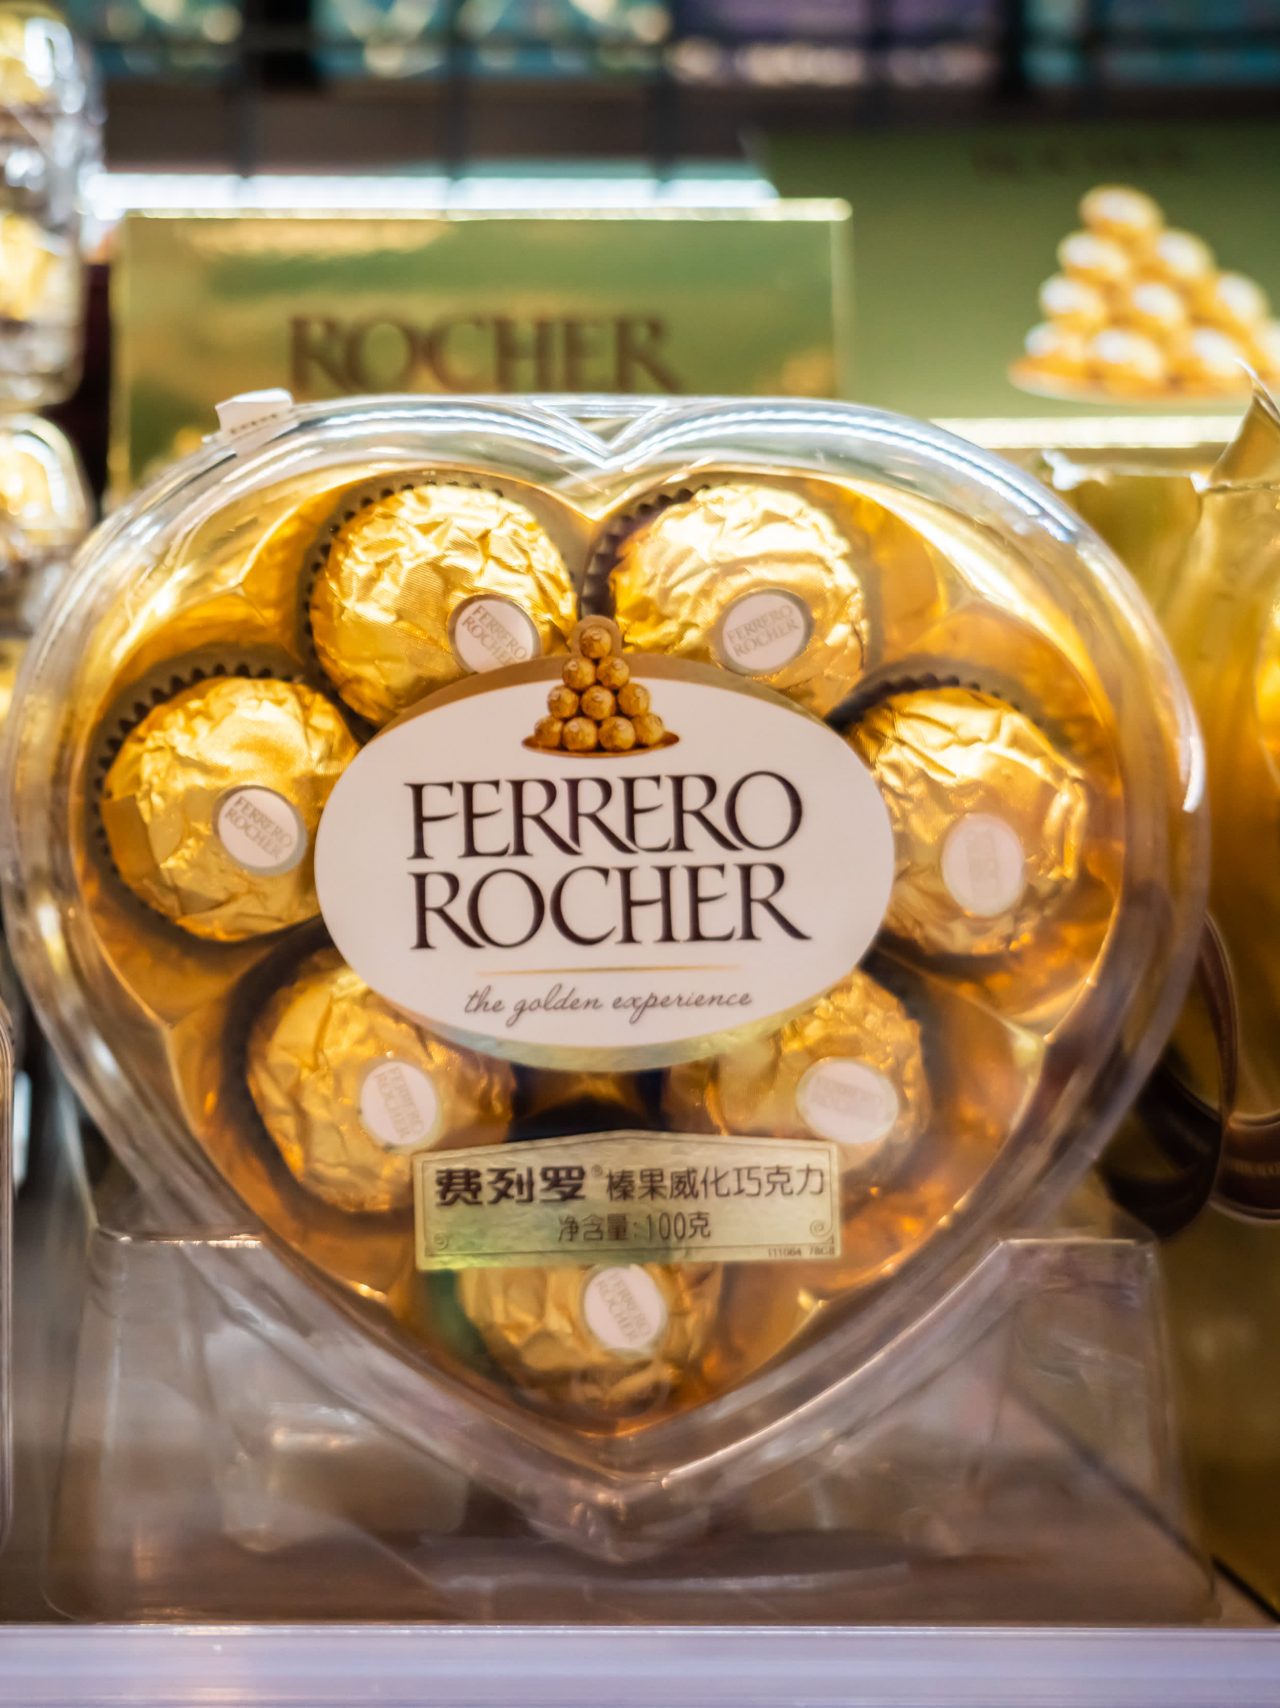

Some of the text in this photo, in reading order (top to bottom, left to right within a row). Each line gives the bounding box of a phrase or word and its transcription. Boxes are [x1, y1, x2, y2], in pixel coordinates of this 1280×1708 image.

[290, 314, 683, 394] ROCHER
[472, 604, 528, 661] FERRERO
[726, 605, 795, 643] FERRERO
[732, 618, 800, 657] ROCHER
[223, 808, 284, 860] ROCHER
[232, 796, 293, 847] FERRERO
[404, 770, 804, 860] FERRERO
[409, 862, 812, 950] ROCHER
[464, 983, 754, 1028] the golden experience
